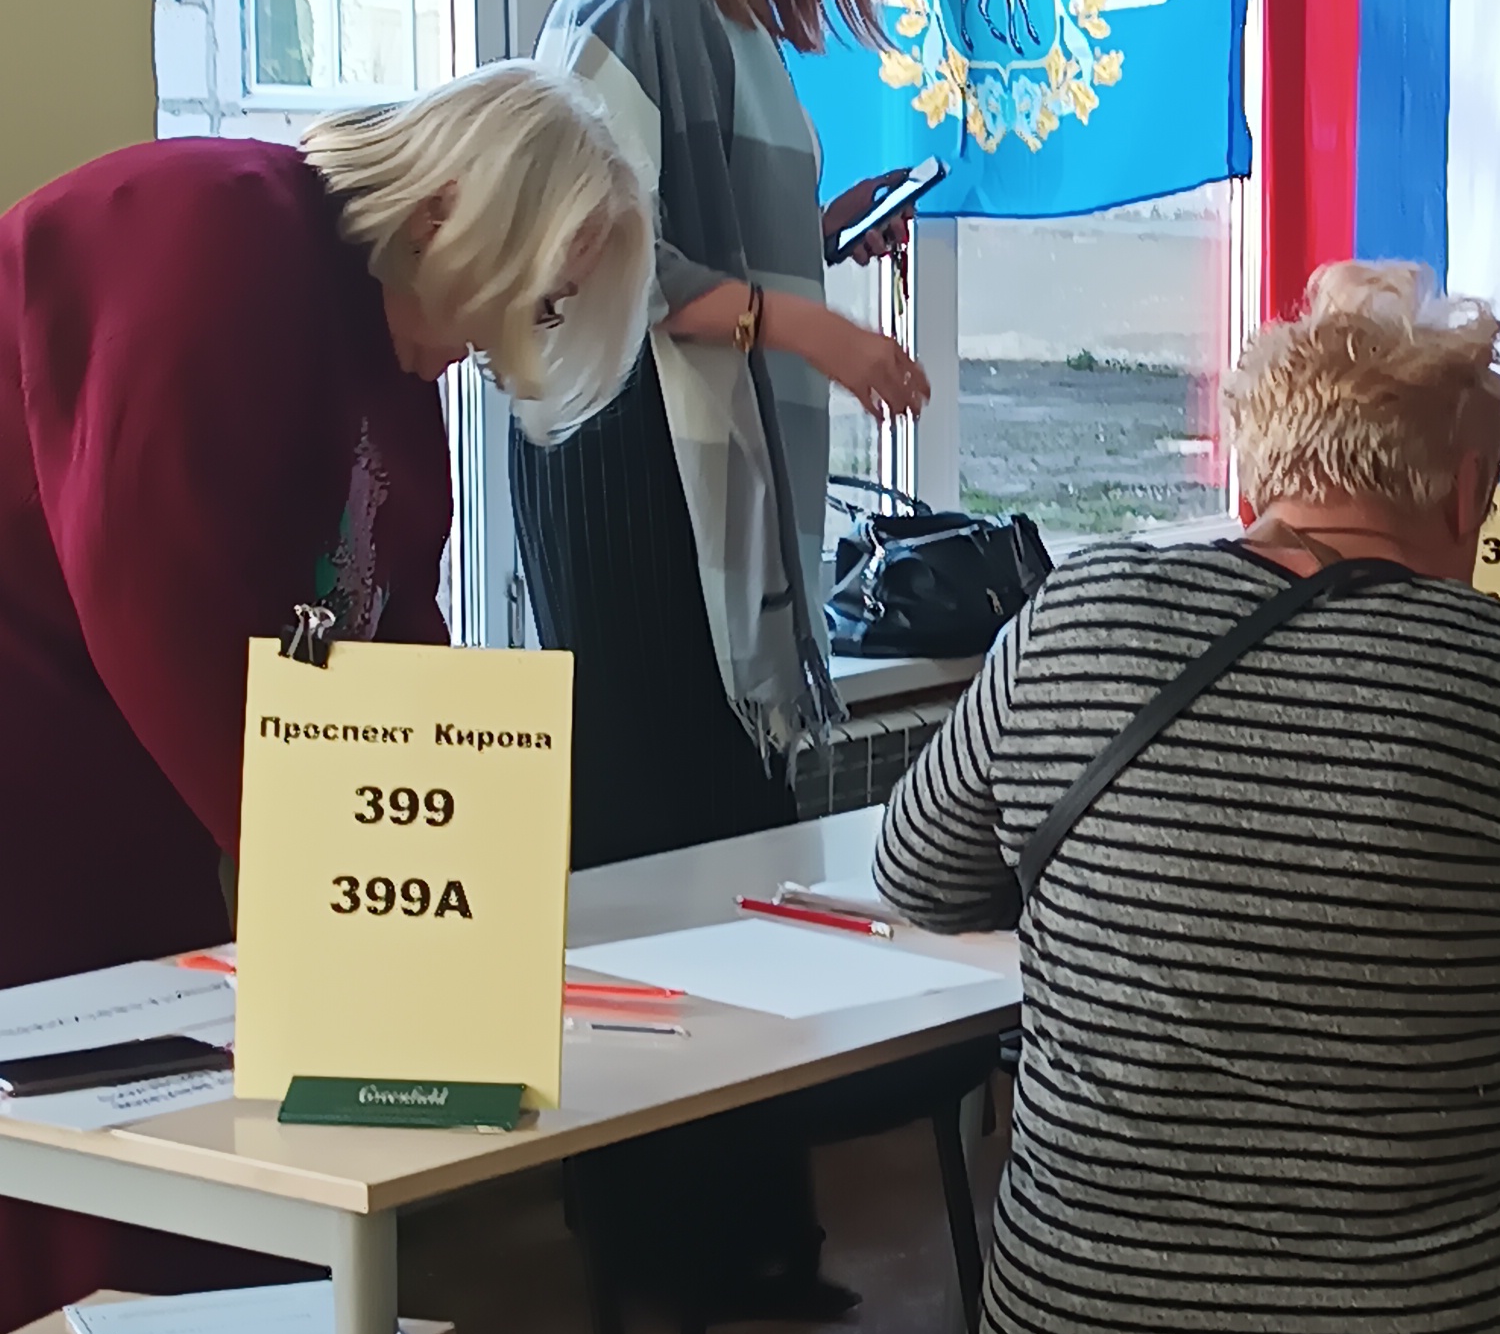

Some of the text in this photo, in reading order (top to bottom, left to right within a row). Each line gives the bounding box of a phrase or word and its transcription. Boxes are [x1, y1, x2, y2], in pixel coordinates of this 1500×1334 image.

[260, 716, 552, 752] Проспект Кирова
[354, 785, 455, 827] 399
[330, 875, 473, 920] 399А
